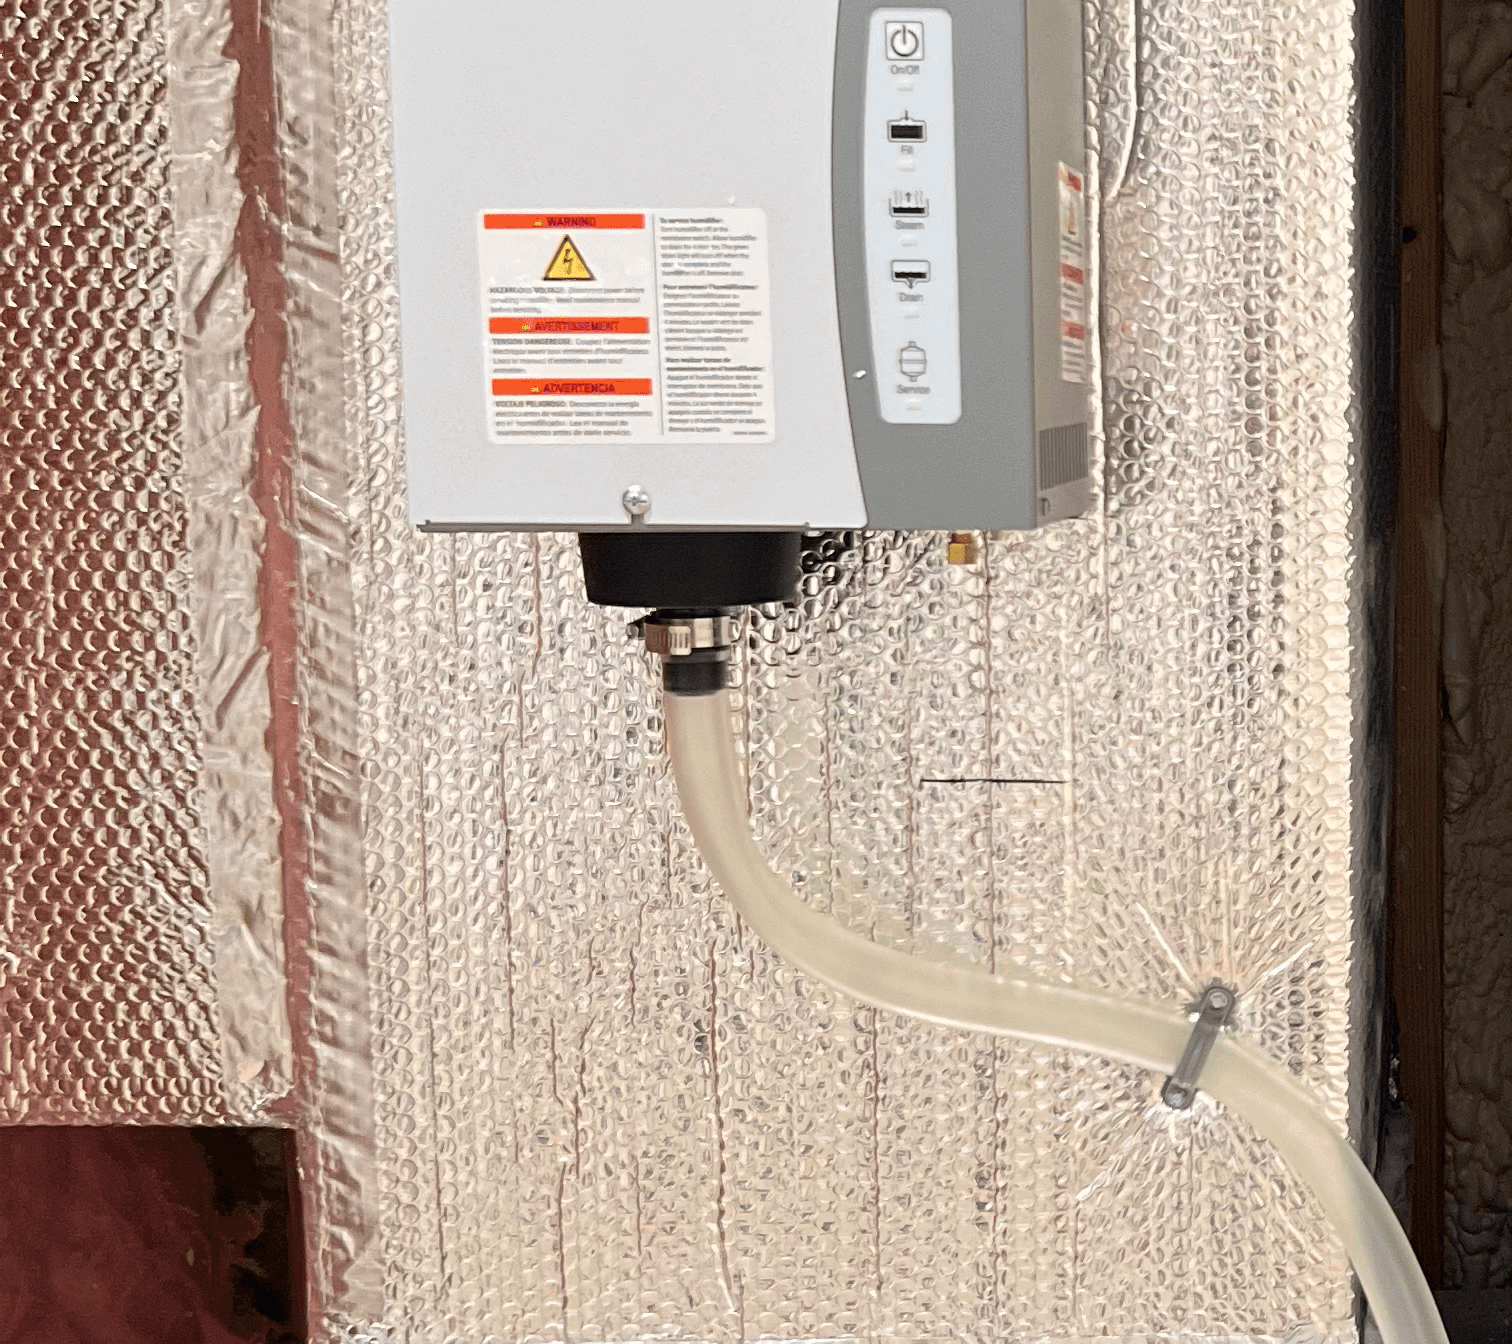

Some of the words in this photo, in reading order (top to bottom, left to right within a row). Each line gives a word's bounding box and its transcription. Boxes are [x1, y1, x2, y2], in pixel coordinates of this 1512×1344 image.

[546, 216, 597, 227] WARNING
[535, 320, 620, 331] AVERTISSEMENT
[543, 382, 616, 393] ADVERTENCIA
